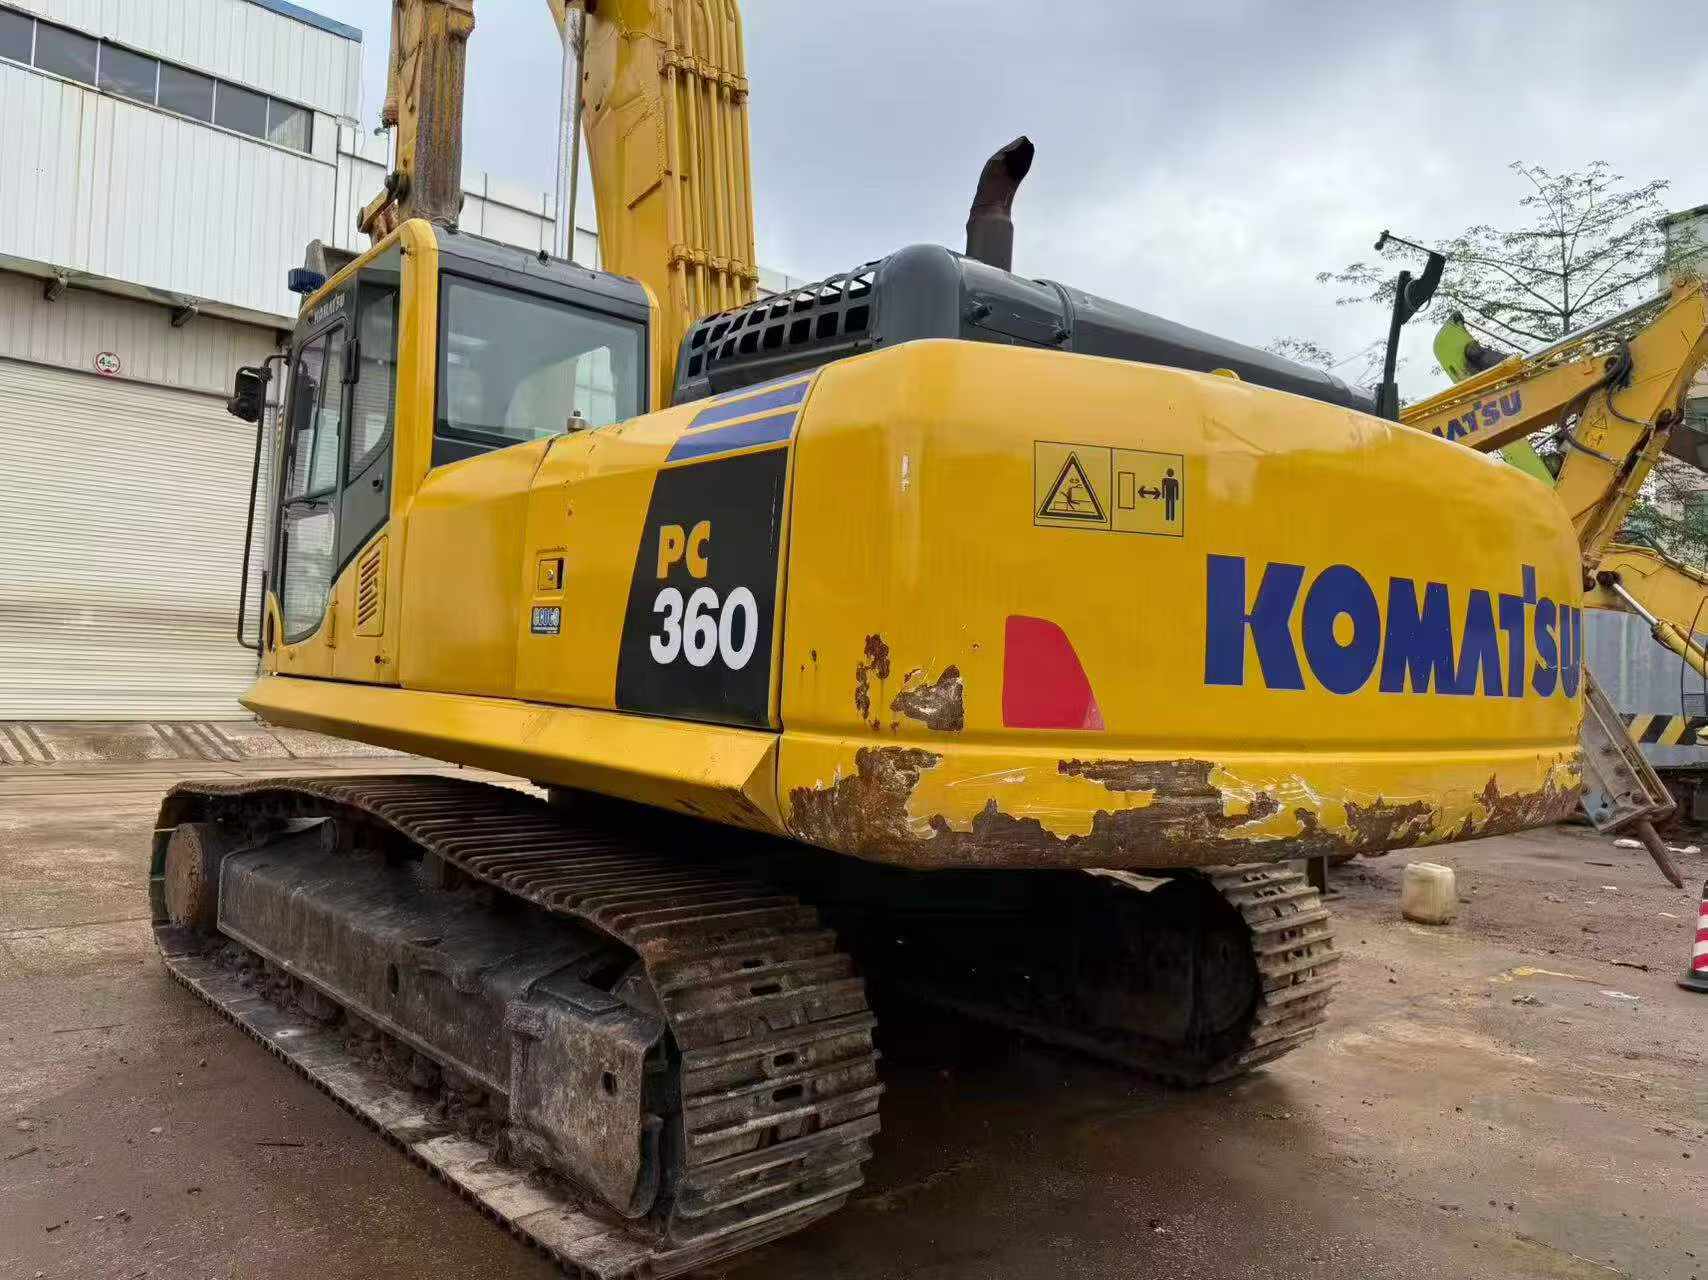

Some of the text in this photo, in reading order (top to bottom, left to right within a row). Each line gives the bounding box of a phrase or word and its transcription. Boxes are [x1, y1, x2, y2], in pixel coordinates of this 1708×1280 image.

[656, 520, 711, 579] PC
[650, 586, 758, 670] 360
[1204, 553, 1581, 698] KOMATSU
